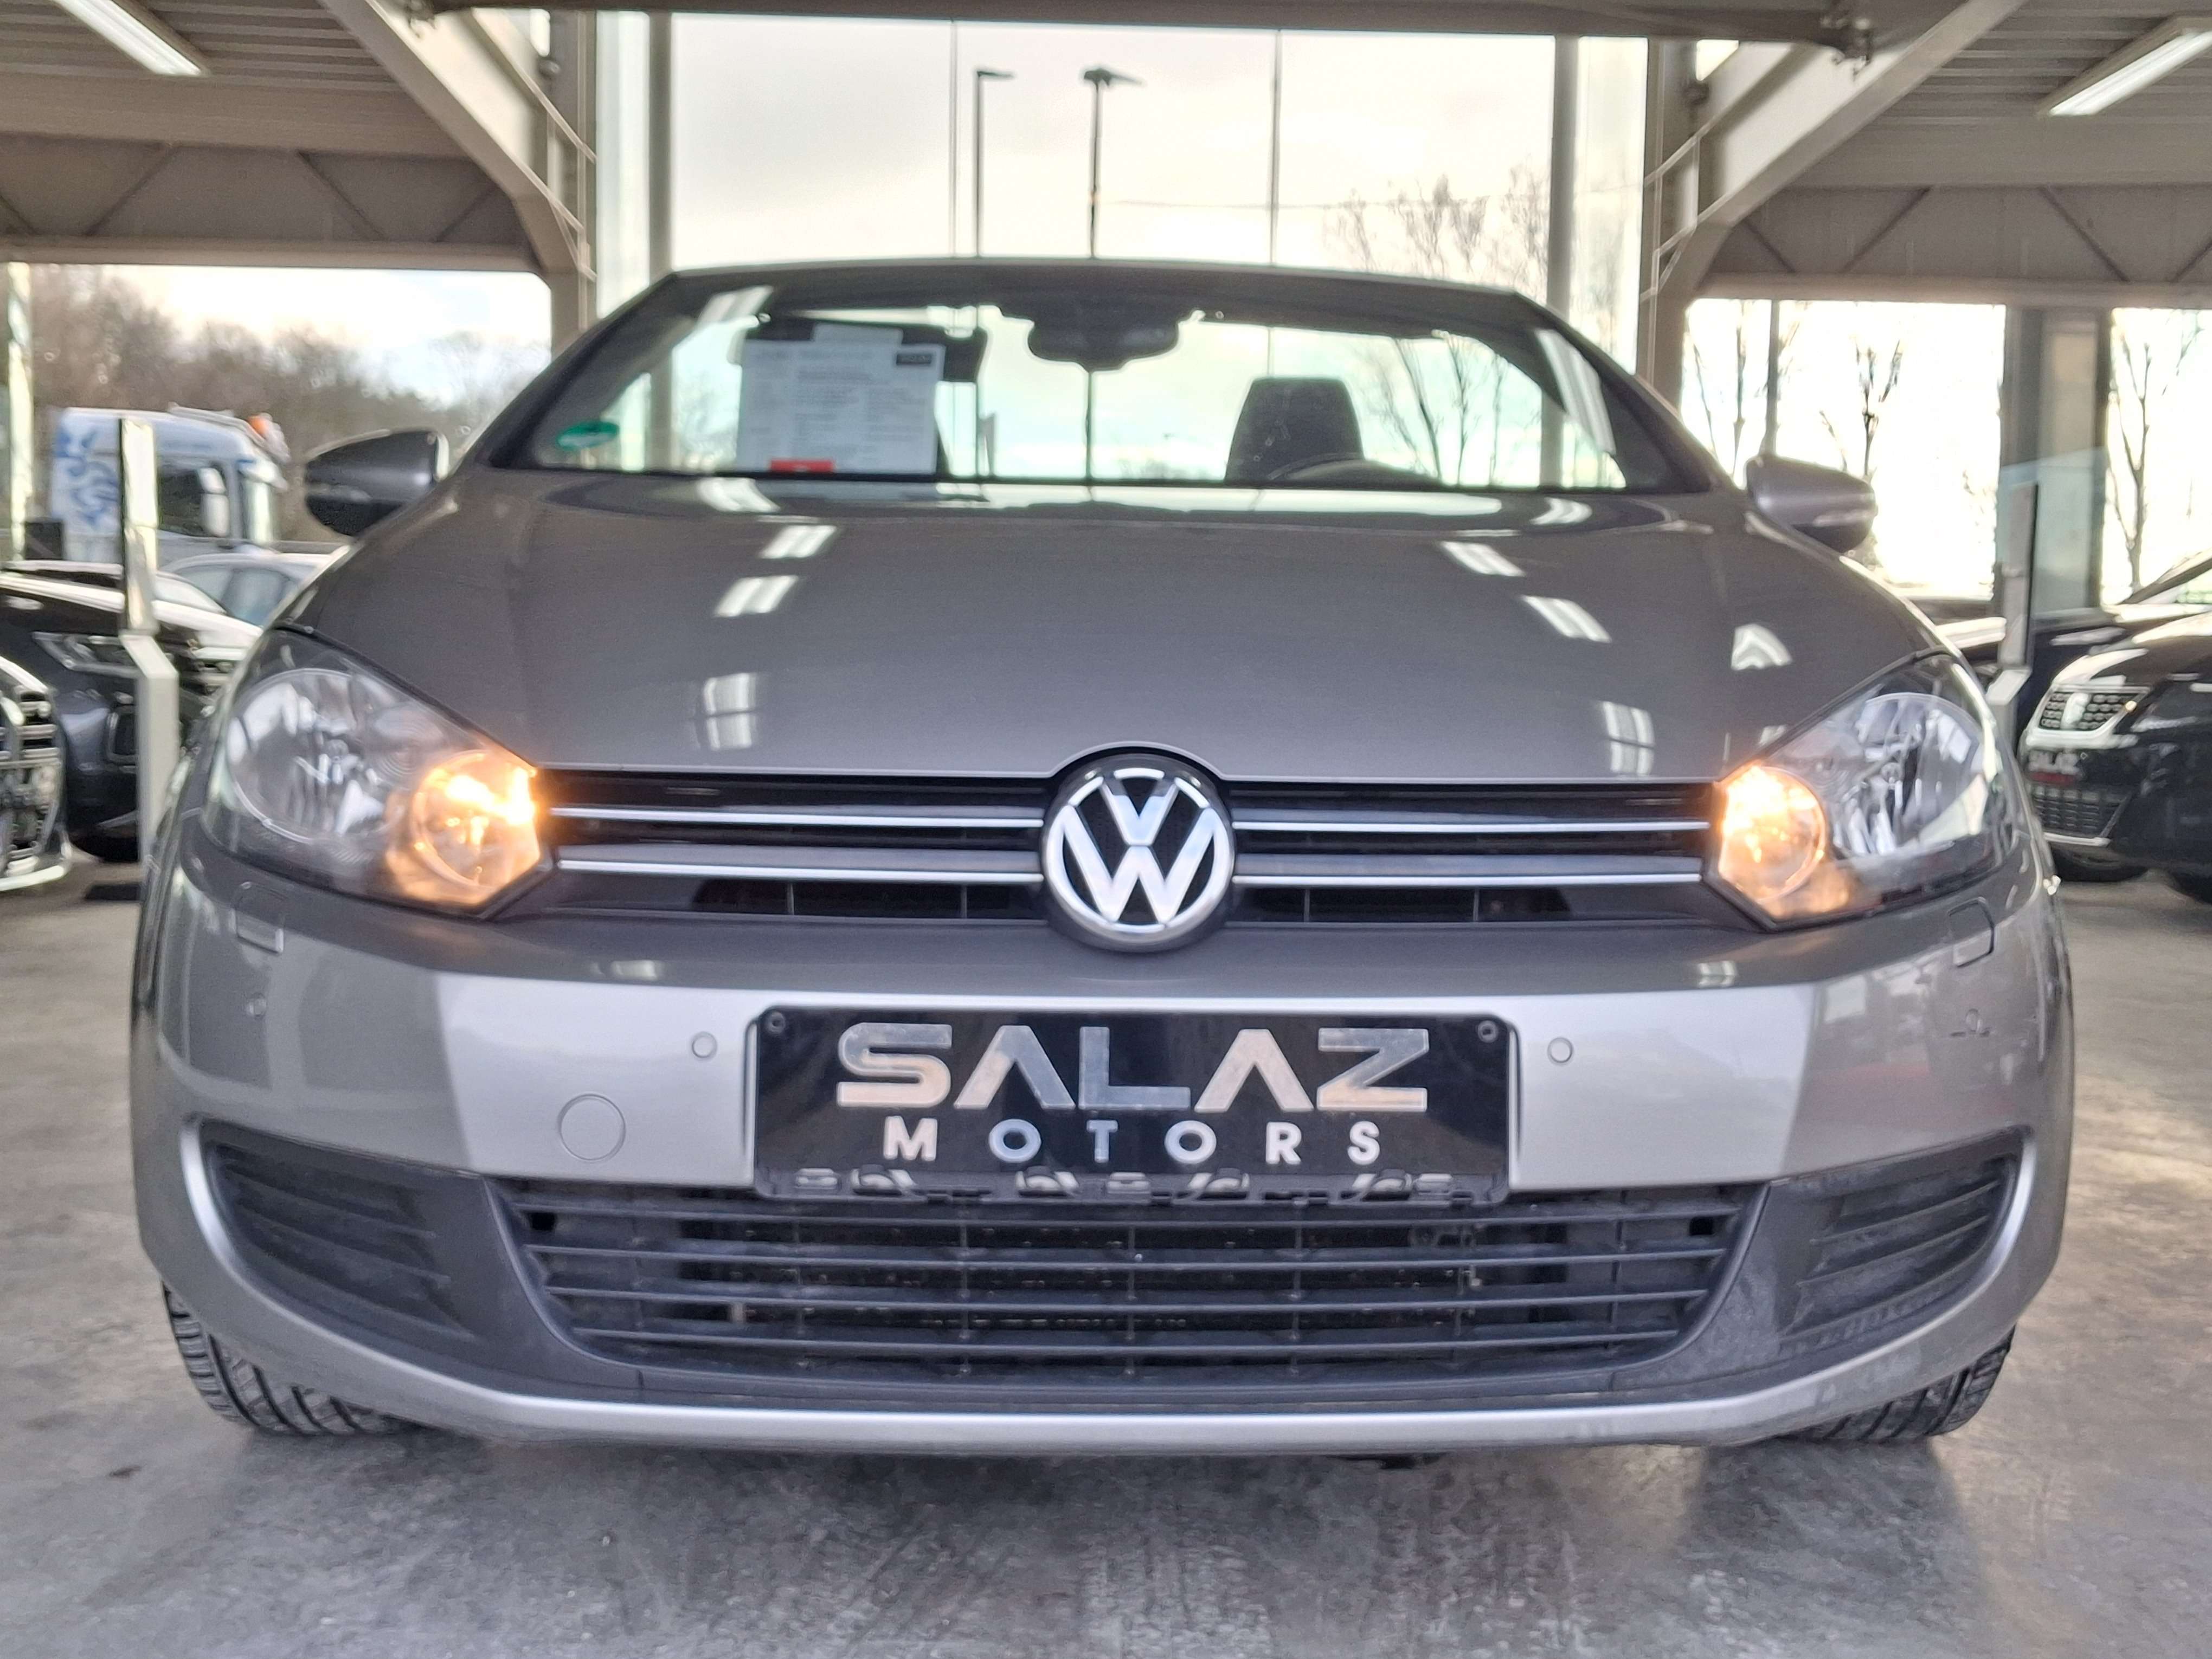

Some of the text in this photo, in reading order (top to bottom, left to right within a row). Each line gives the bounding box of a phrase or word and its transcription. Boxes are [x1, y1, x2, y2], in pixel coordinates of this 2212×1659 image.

[1046, 768, 1232, 933] VW
[835, 1021, 1430, 1113] SALAZ
[883, 1115, 1381, 1165] MOTORS
